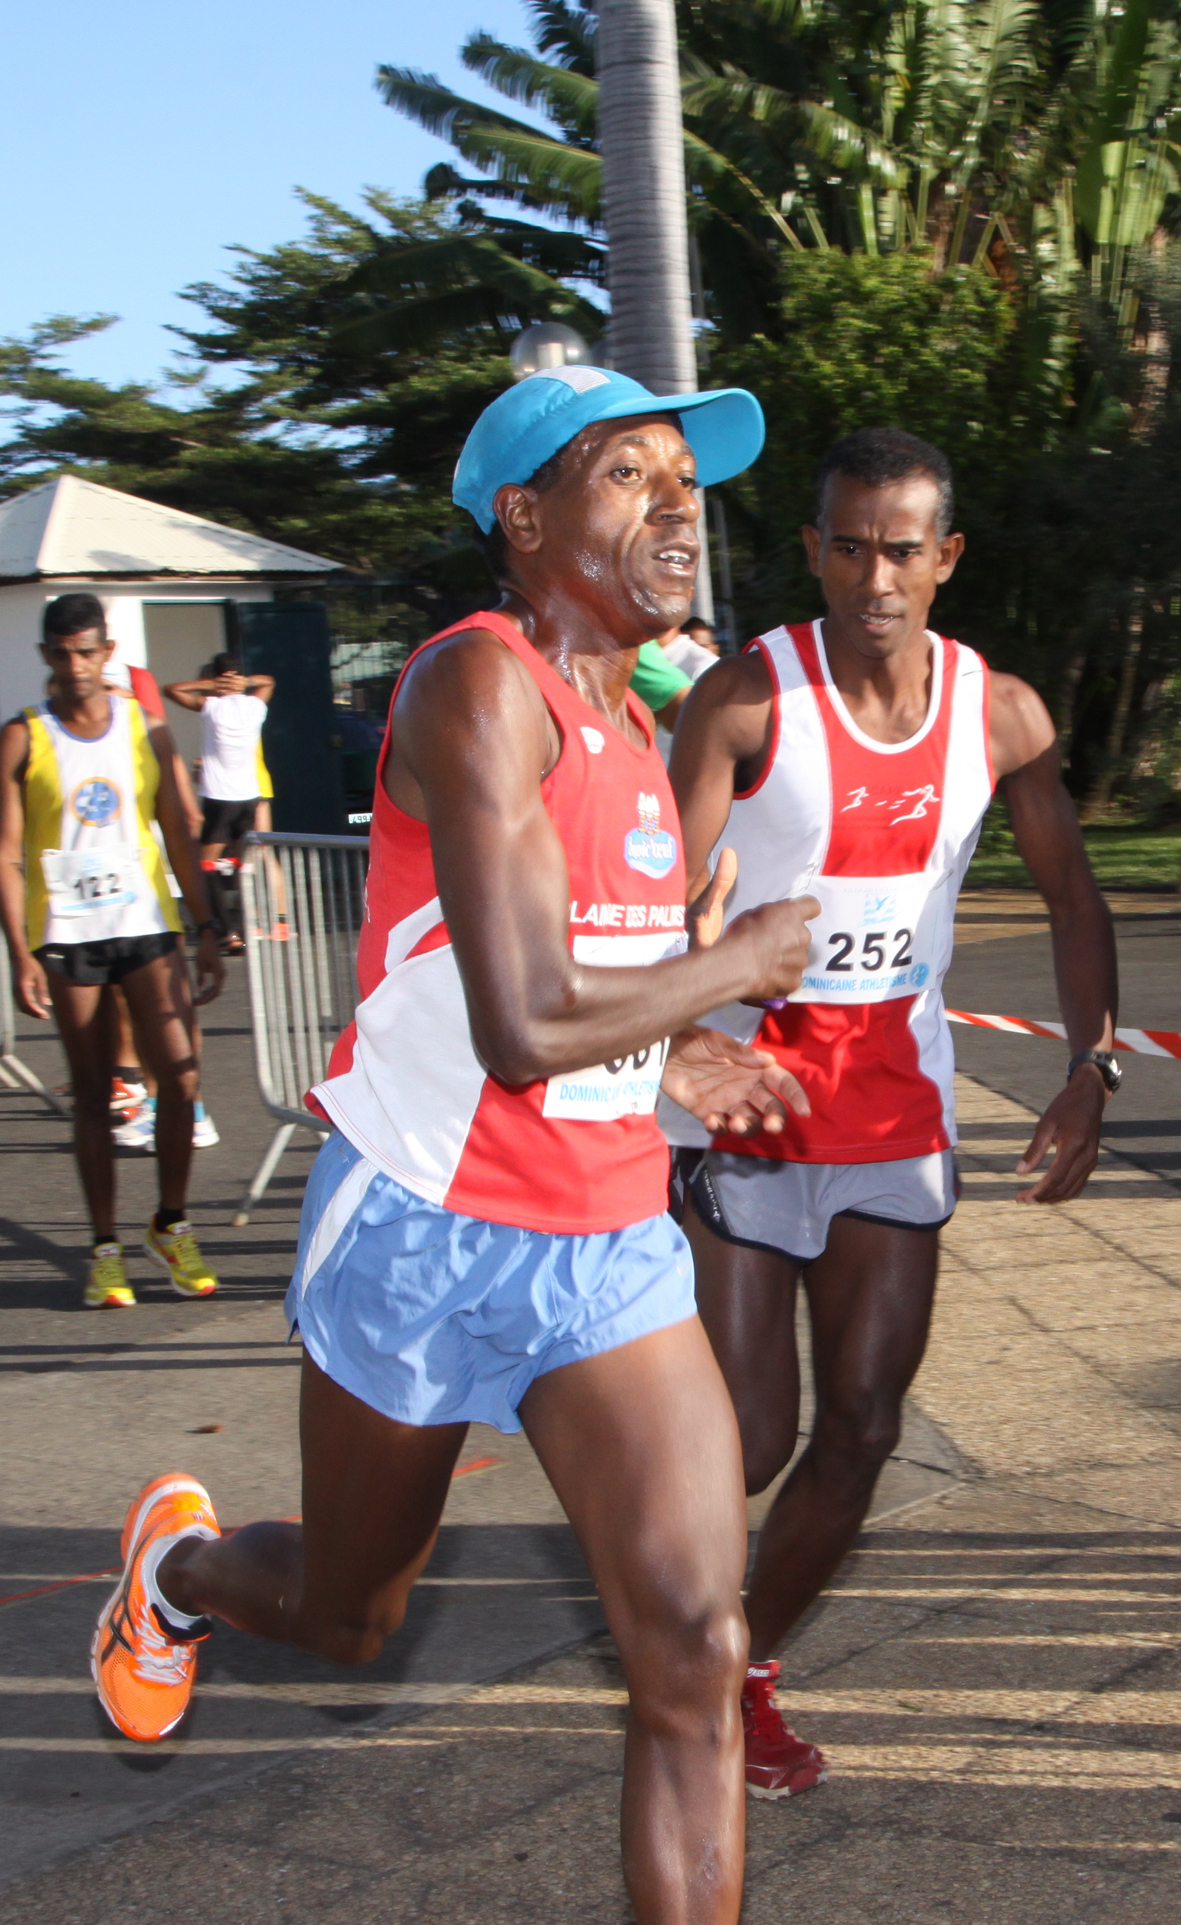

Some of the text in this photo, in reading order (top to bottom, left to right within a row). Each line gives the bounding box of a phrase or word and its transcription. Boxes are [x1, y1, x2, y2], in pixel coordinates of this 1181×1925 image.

[73, 873, 121, 899] 122
[569, 901, 625, 927] LAINE
[825, 927, 914, 971] 252
[801, 976, 856, 991] OMINICAINE
